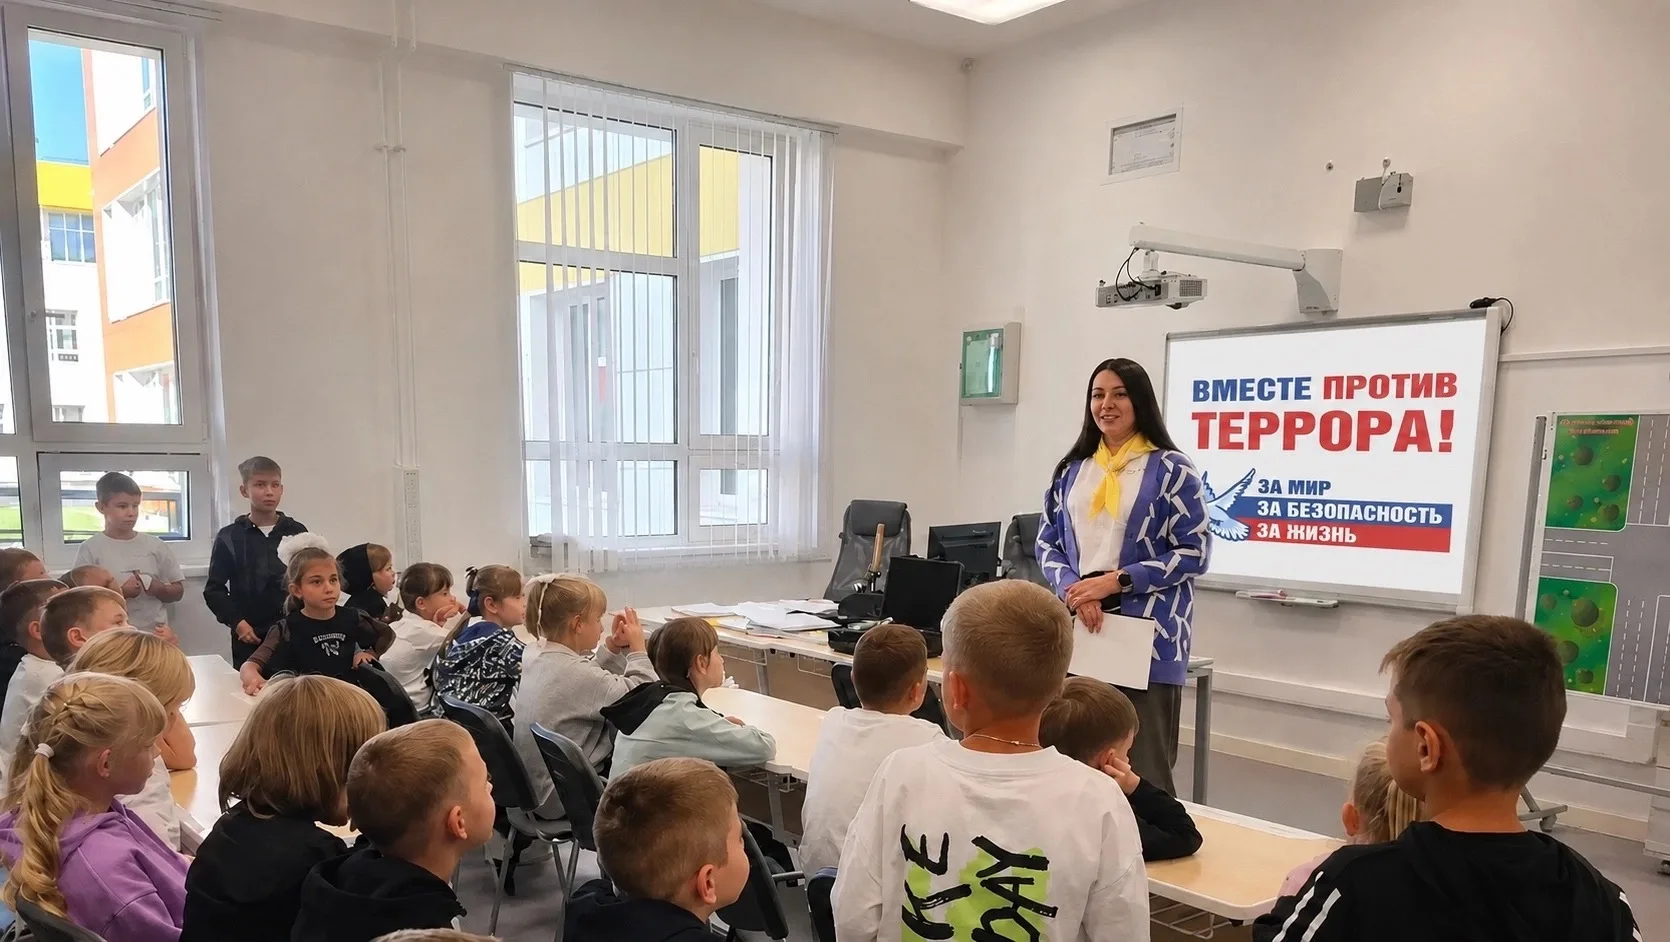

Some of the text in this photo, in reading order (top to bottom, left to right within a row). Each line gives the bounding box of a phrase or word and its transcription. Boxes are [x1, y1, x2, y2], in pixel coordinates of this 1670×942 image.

[1193, 373, 1457, 402] ВМЕСТЕ ПРОТИВ
[1192, 410, 1454, 452] ТЕРРОРА!
[1258, 479, 1331, 495] ЗА МИР
[1258, 501, 1443, 524] ЗА БЕЗОПАСНОСТЬ
[1257, 523, 1357, 543] ЗА ЖИЗНЬ
